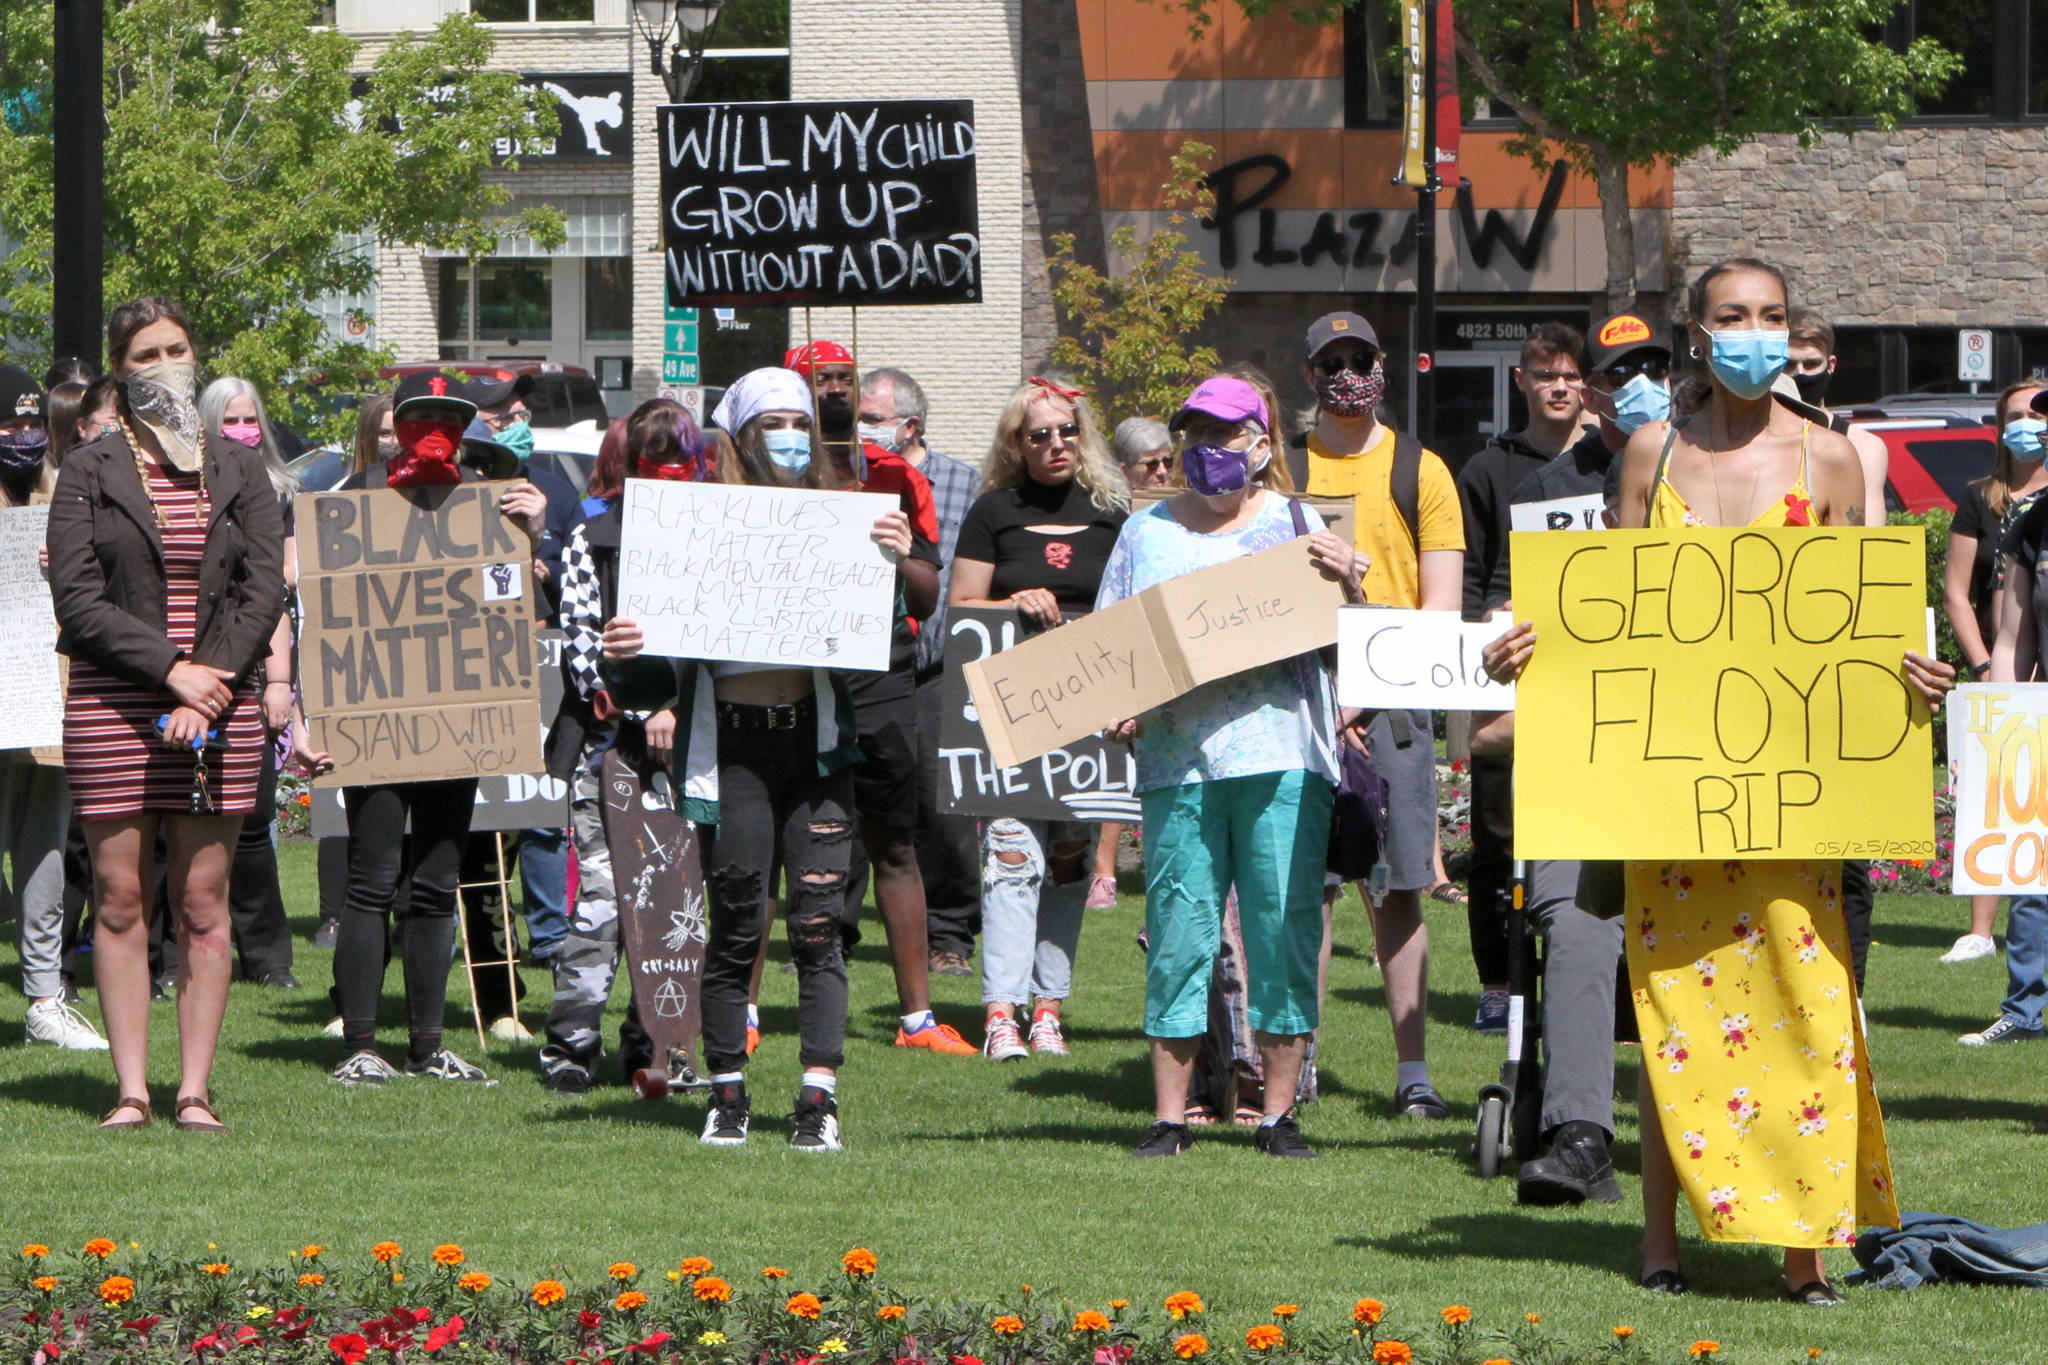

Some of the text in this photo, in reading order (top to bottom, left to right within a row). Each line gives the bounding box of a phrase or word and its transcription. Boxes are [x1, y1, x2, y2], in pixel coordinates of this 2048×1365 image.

[1409, 7, 1421, 149] RED DEER
[803, 107, 879, 173] MY
[670, 180, 922, 241] GROW UP
[1456, 157, 1571, 271] W
[837, 245, 868, 292] A
[870, 232, 980, 298] DAD?
[1456, 322, 1492, 338] 4822
[1496, 322, 1528, 338] 50th
[664, 359, 697, 378] 49 Ave
[314, 485, 517, 571] BLACK
[685, 527, 829, 561] MATTER
[625, 594, 707, 618] BLACK
[695, 580, 839, 609] MATTERS
[1558, 532, 1913, 645] GEORGE
[319, 616, 533, 709] MATTER!
[993, 594, 1296, 731] Equality Justice
[336, 712, 441, 768] STAND
[438, 704, 516, 747] WITH
[1589, 659, 1913, 764] FLOYD
[1965, 692, 2011, 732] IF
[463, 747, 517, 774] YOU
[938, 747, 1030, 800] THE
[1694, 770, 1823, 854] RIP
[1813, 839, 1935, 857] 05/25/2020
